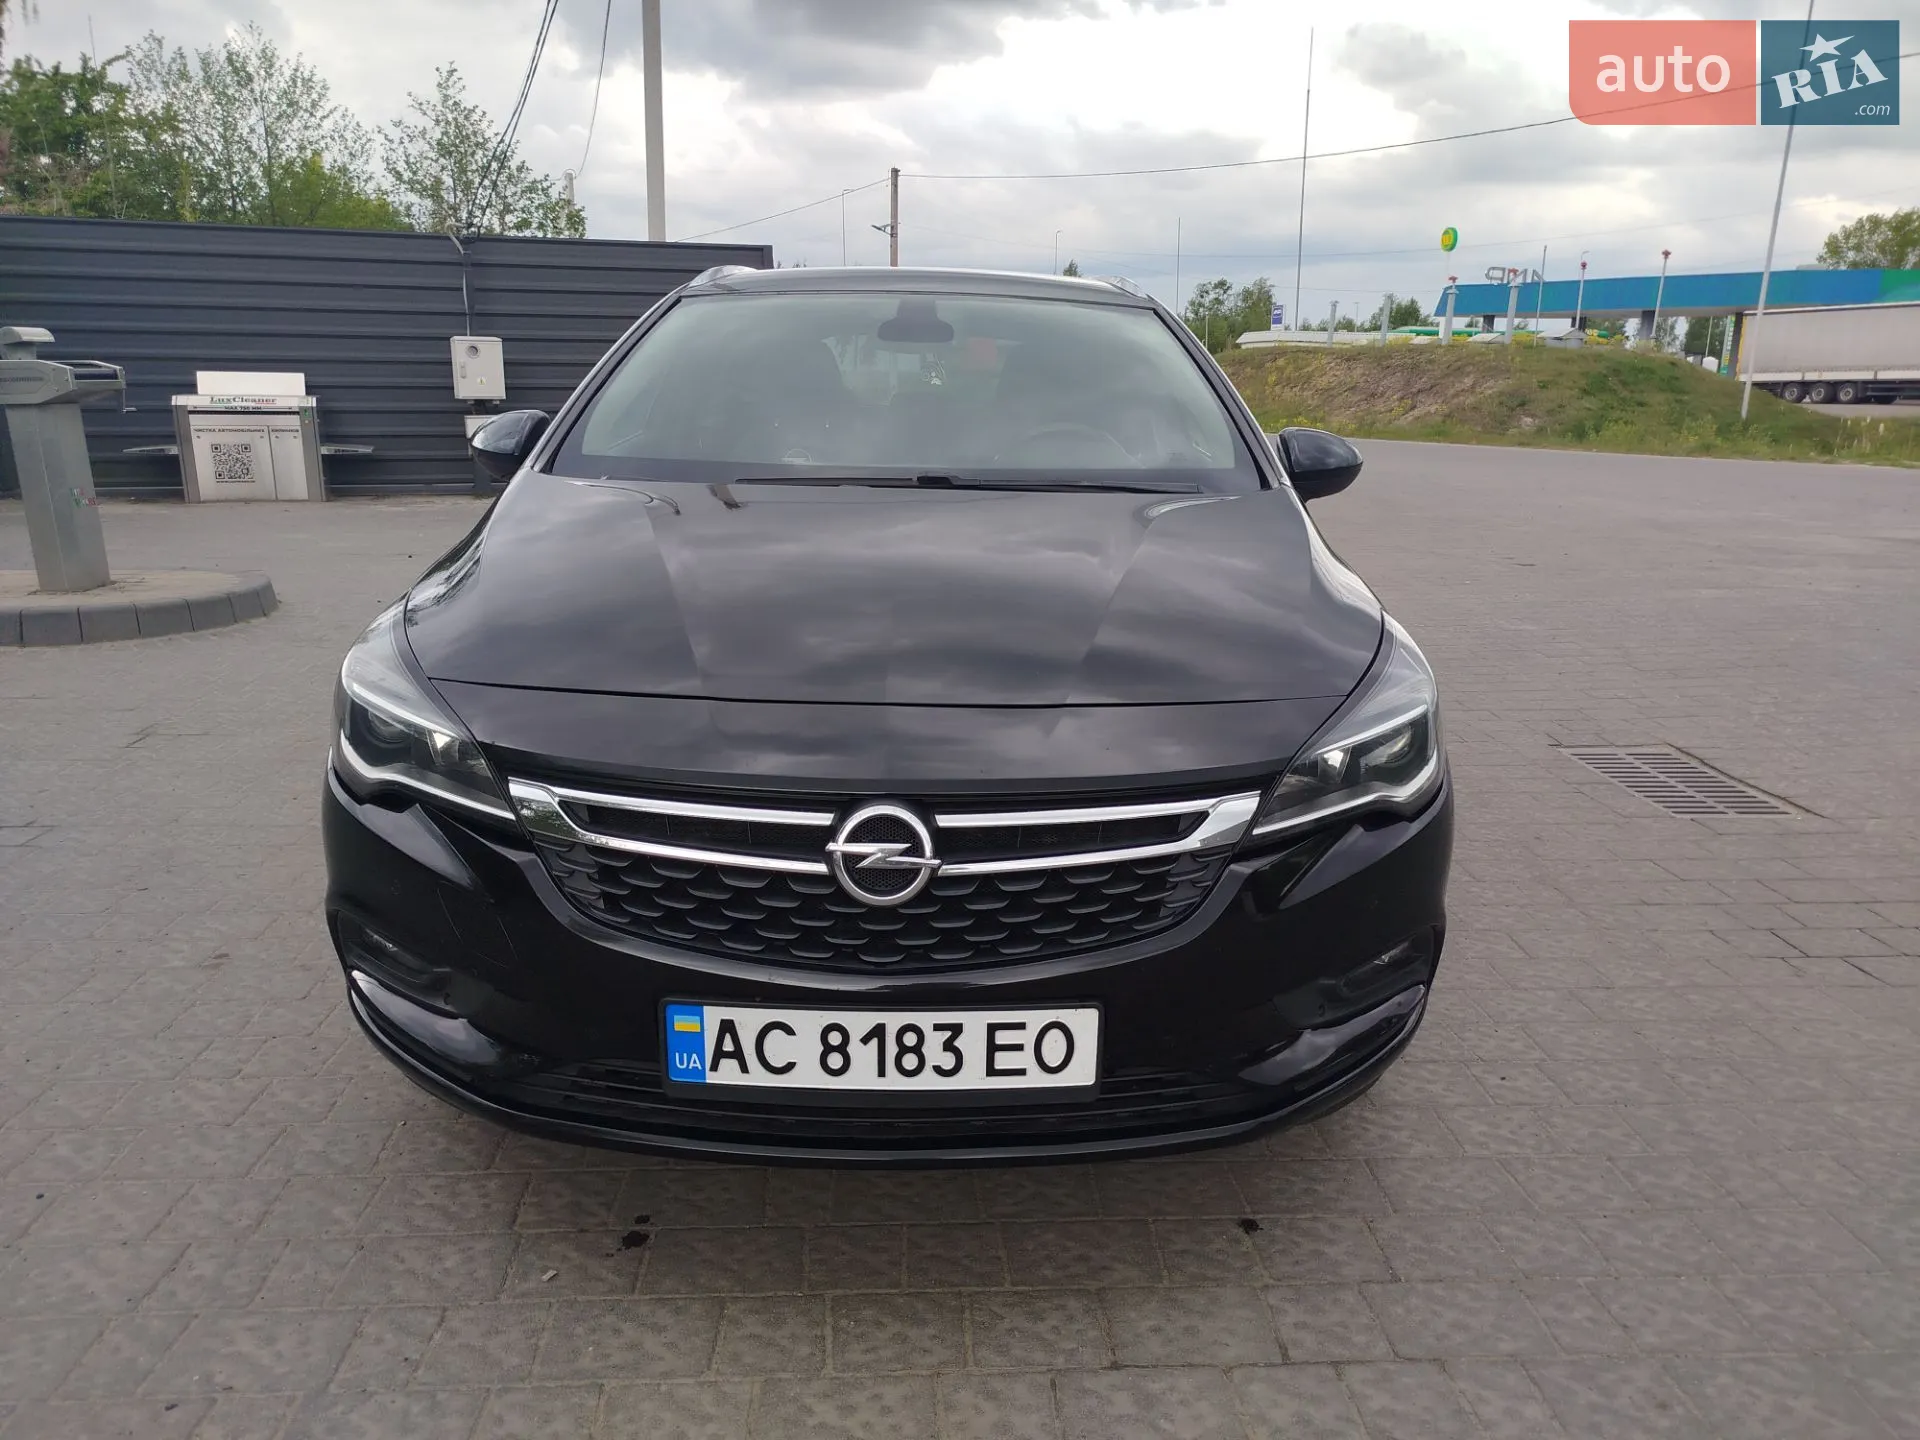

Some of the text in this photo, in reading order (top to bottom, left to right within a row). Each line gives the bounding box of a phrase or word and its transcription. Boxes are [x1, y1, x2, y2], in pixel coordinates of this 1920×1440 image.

[210, 396, 277, 404] LuxCleaner
[709, 1018, 1075, 1078] AC 8183 EO
[675, 1052, 703, 1070] UA
